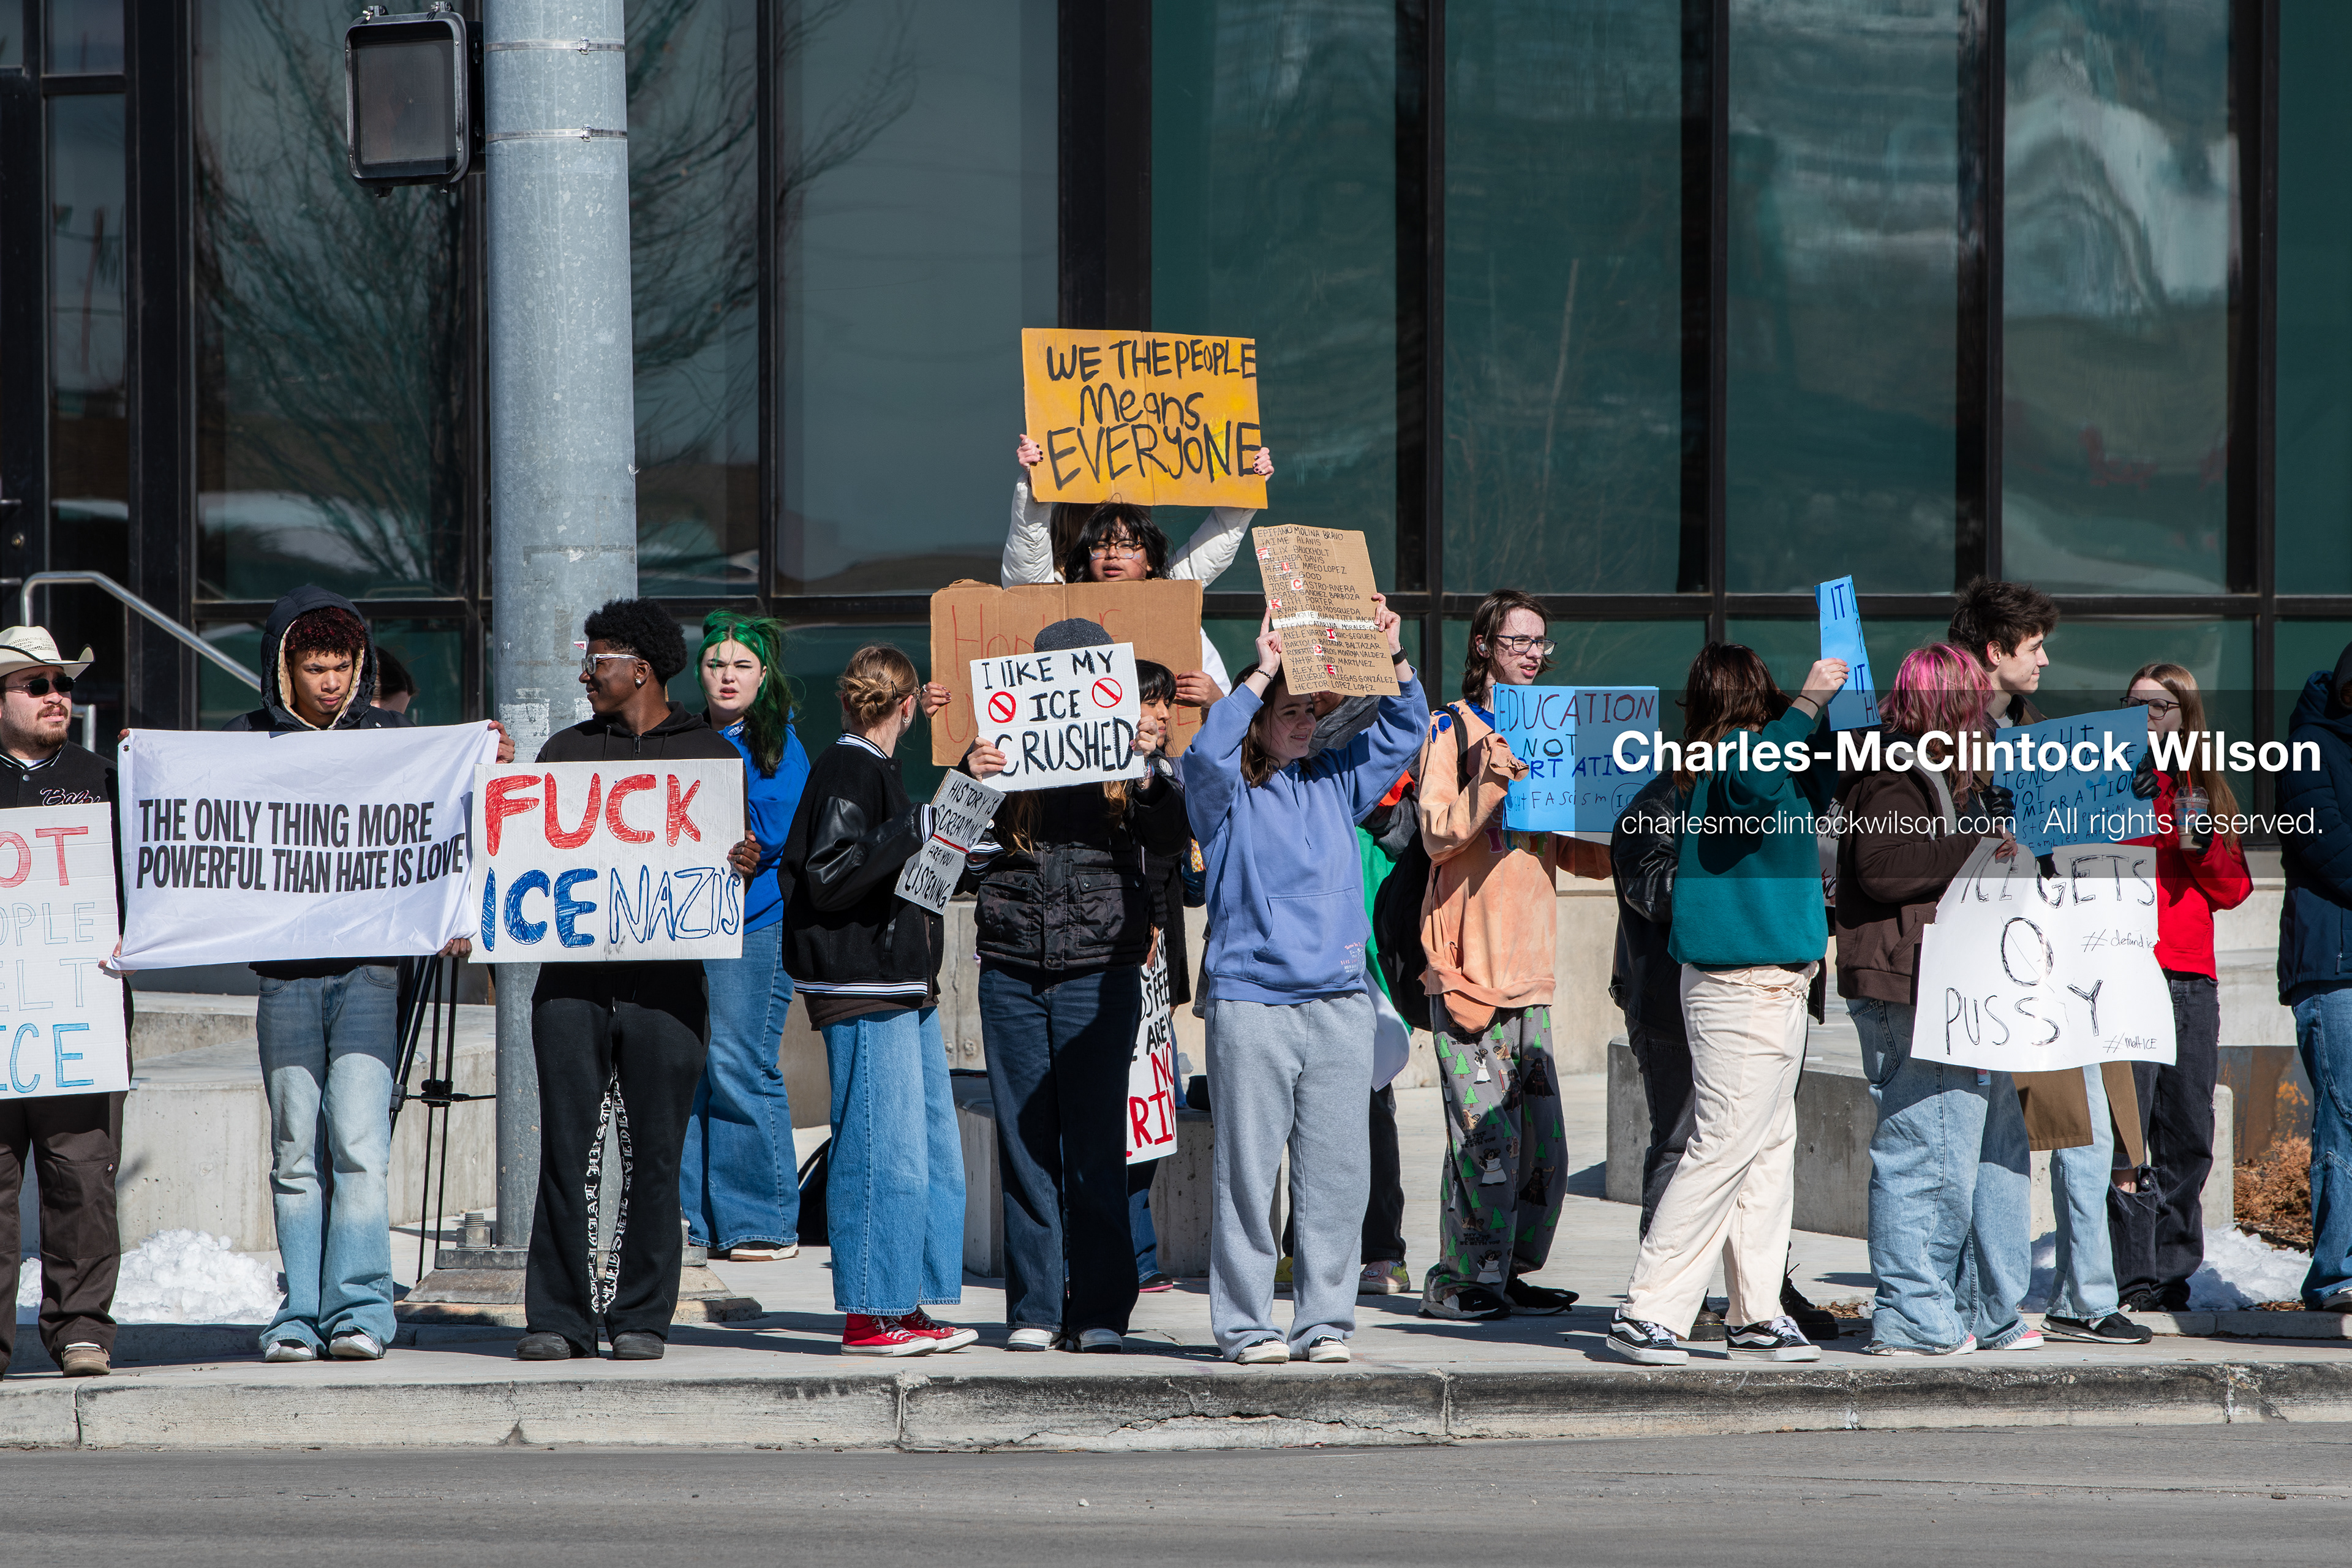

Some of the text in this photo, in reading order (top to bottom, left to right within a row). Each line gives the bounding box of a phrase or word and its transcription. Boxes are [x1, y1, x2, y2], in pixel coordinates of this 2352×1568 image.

[1046, 338, 1256, 382] WE THE PEOPLE
[1080, 382, 1204, 431] Means
[1047, 420, 1262, 491] EVERYONE
[1294, 527, 1320, 537] MOLINA
[1322, 530, 1344, 541] BRAVO
[1262, 536, 1321, 547] JAIME ALANIS
[1293, 545, 1329, 556] BAUCKHOLT
[1304, 554, 1324, 564] DAVIS
[1298, 571, 1321, 580] GOOD
[1303, 563, 1322, 571] MATEO
[1324, 565, 1347, 574] LOPEZ
[1269, 581, 1290, 592] JOSE
[1300, 589, 1328, 598] SANCHEZ
[1329, 592, 1360, 600] BARBOZA
[1271, 596, 1334, 609] KEITH PORTER
[1277, 605, 1297, 615] RYAN
[1323, 606, 1361, 616] MOSQUEDA
[1278, 611, 1314, 623] ENRIQUE
[1281, 620, 1306, 631] ELENA
[1309, 620, 1338, 630] CATARINA
[1283, 630, 1300, 641] AXEL
[1284, 639, 1317, 649] BARTOLO
[1345, 641, 1382, 650] BALTAZAR
[1286, 647, 1314, 656] ROBERTO
[1360, 650, 1387, 659] VALDEZ
[1289, 655, 1375, 668] YAHIR DAVID MARTINEZ
[981, 662, 993, 690] I
[1071, 649, 1114, 676] MY
[1292, 665, 1313, 675] ALEX
[1294, 671, 1325, 682] SILVERIO
[1327, 673, 1358, 682] VILLEGAS
[1295, 680, 1376, 692] HECTOR LOPEZ LOPEZ
[1028, 689, 1081, 722] ICE
[1500, 688, 1655, 733] EDUCATION
[995, 715, 1135, 777] CRUSHED
[1523, 734, 1578, 758] NOT
[948, 780, 989, 817] HISTORY
[484, 772, 702, 856] FUCK
[138, 798, 435, 848] THE ONLY THING MORE
[935, 804, 982, 848] SCREAMING
[136, 832, 466, 894] POWERFUL THAN HATE IS LOVE
[926, 845, 955, 867] ARE YOU
[905, 862, 951, 910] LISTENING
[2034, 854, 2155, 909] GETS
[481, 866, 599, 952] ICE
[1945, 979, 2103, 1056] PUSSY
